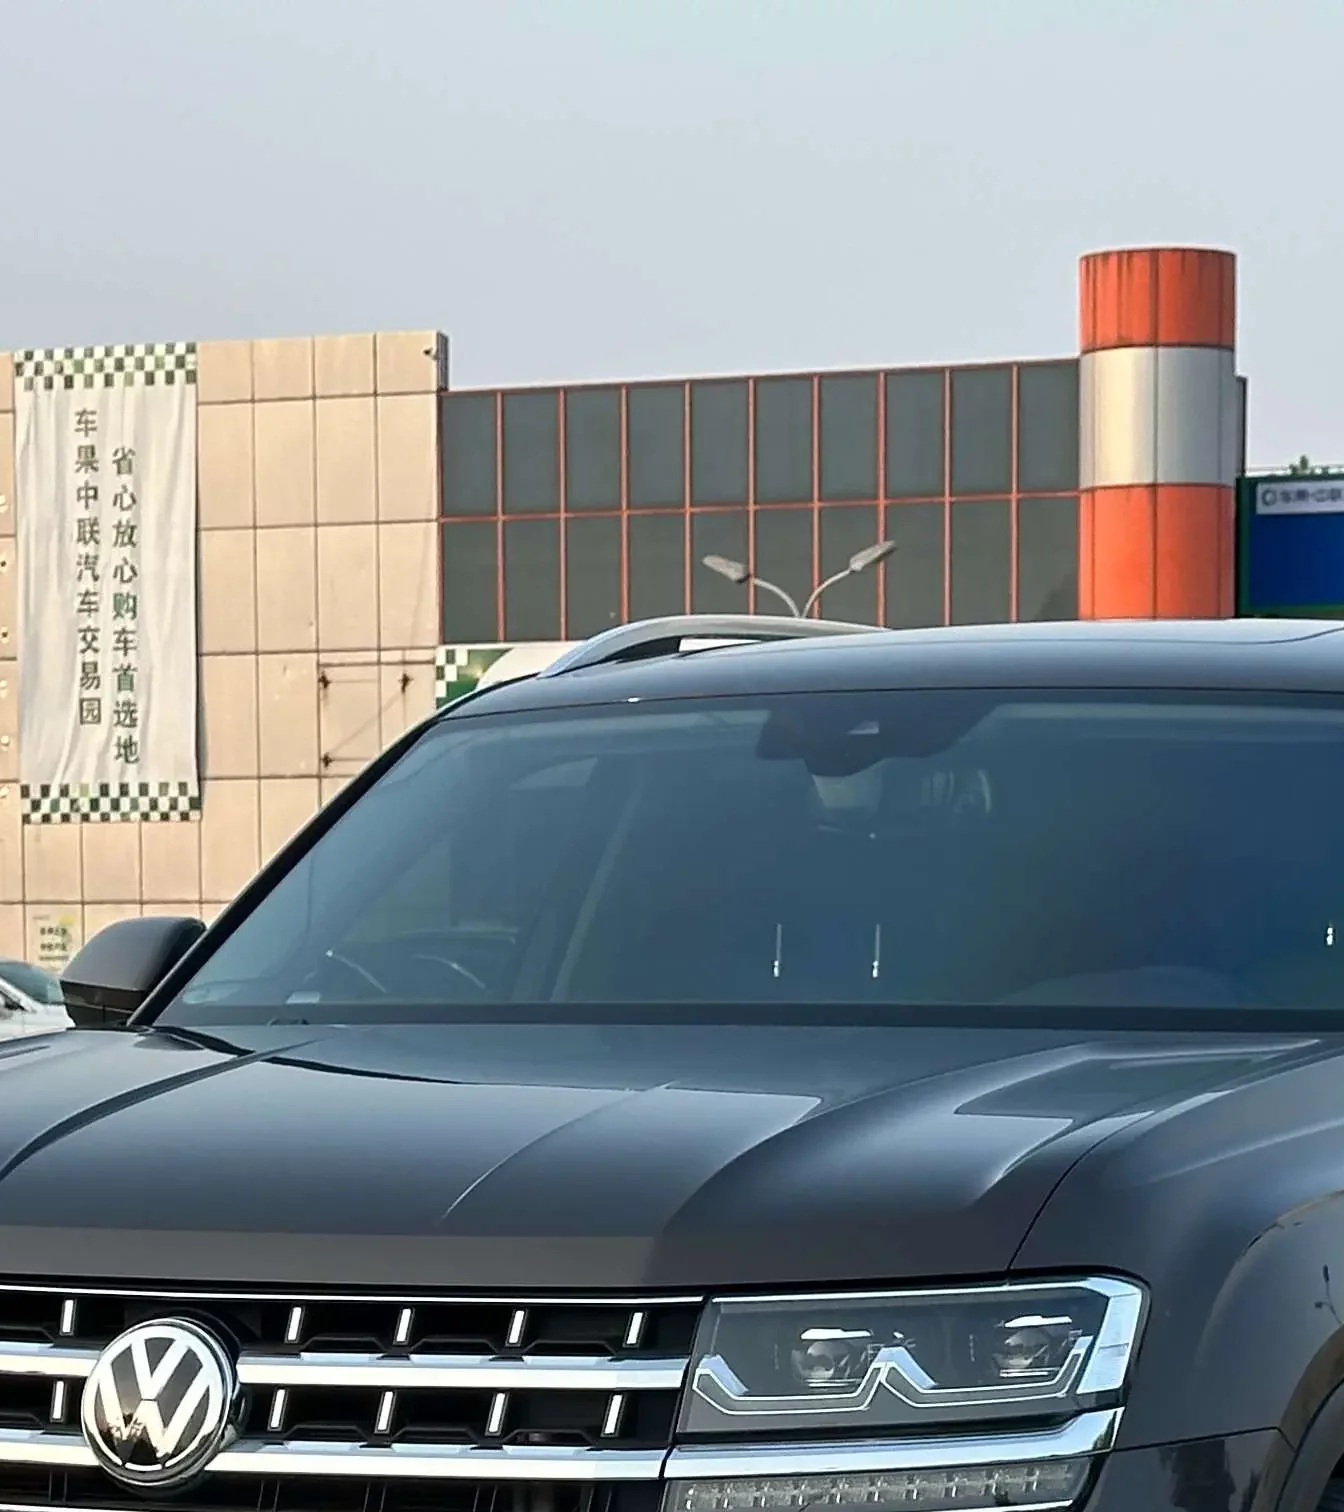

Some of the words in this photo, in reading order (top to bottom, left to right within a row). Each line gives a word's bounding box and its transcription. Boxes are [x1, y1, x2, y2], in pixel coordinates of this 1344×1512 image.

[74, 408, 101, 725] 车果中联汽车交易园
[112, 446, 140, 765] 省心放心购车首选地
